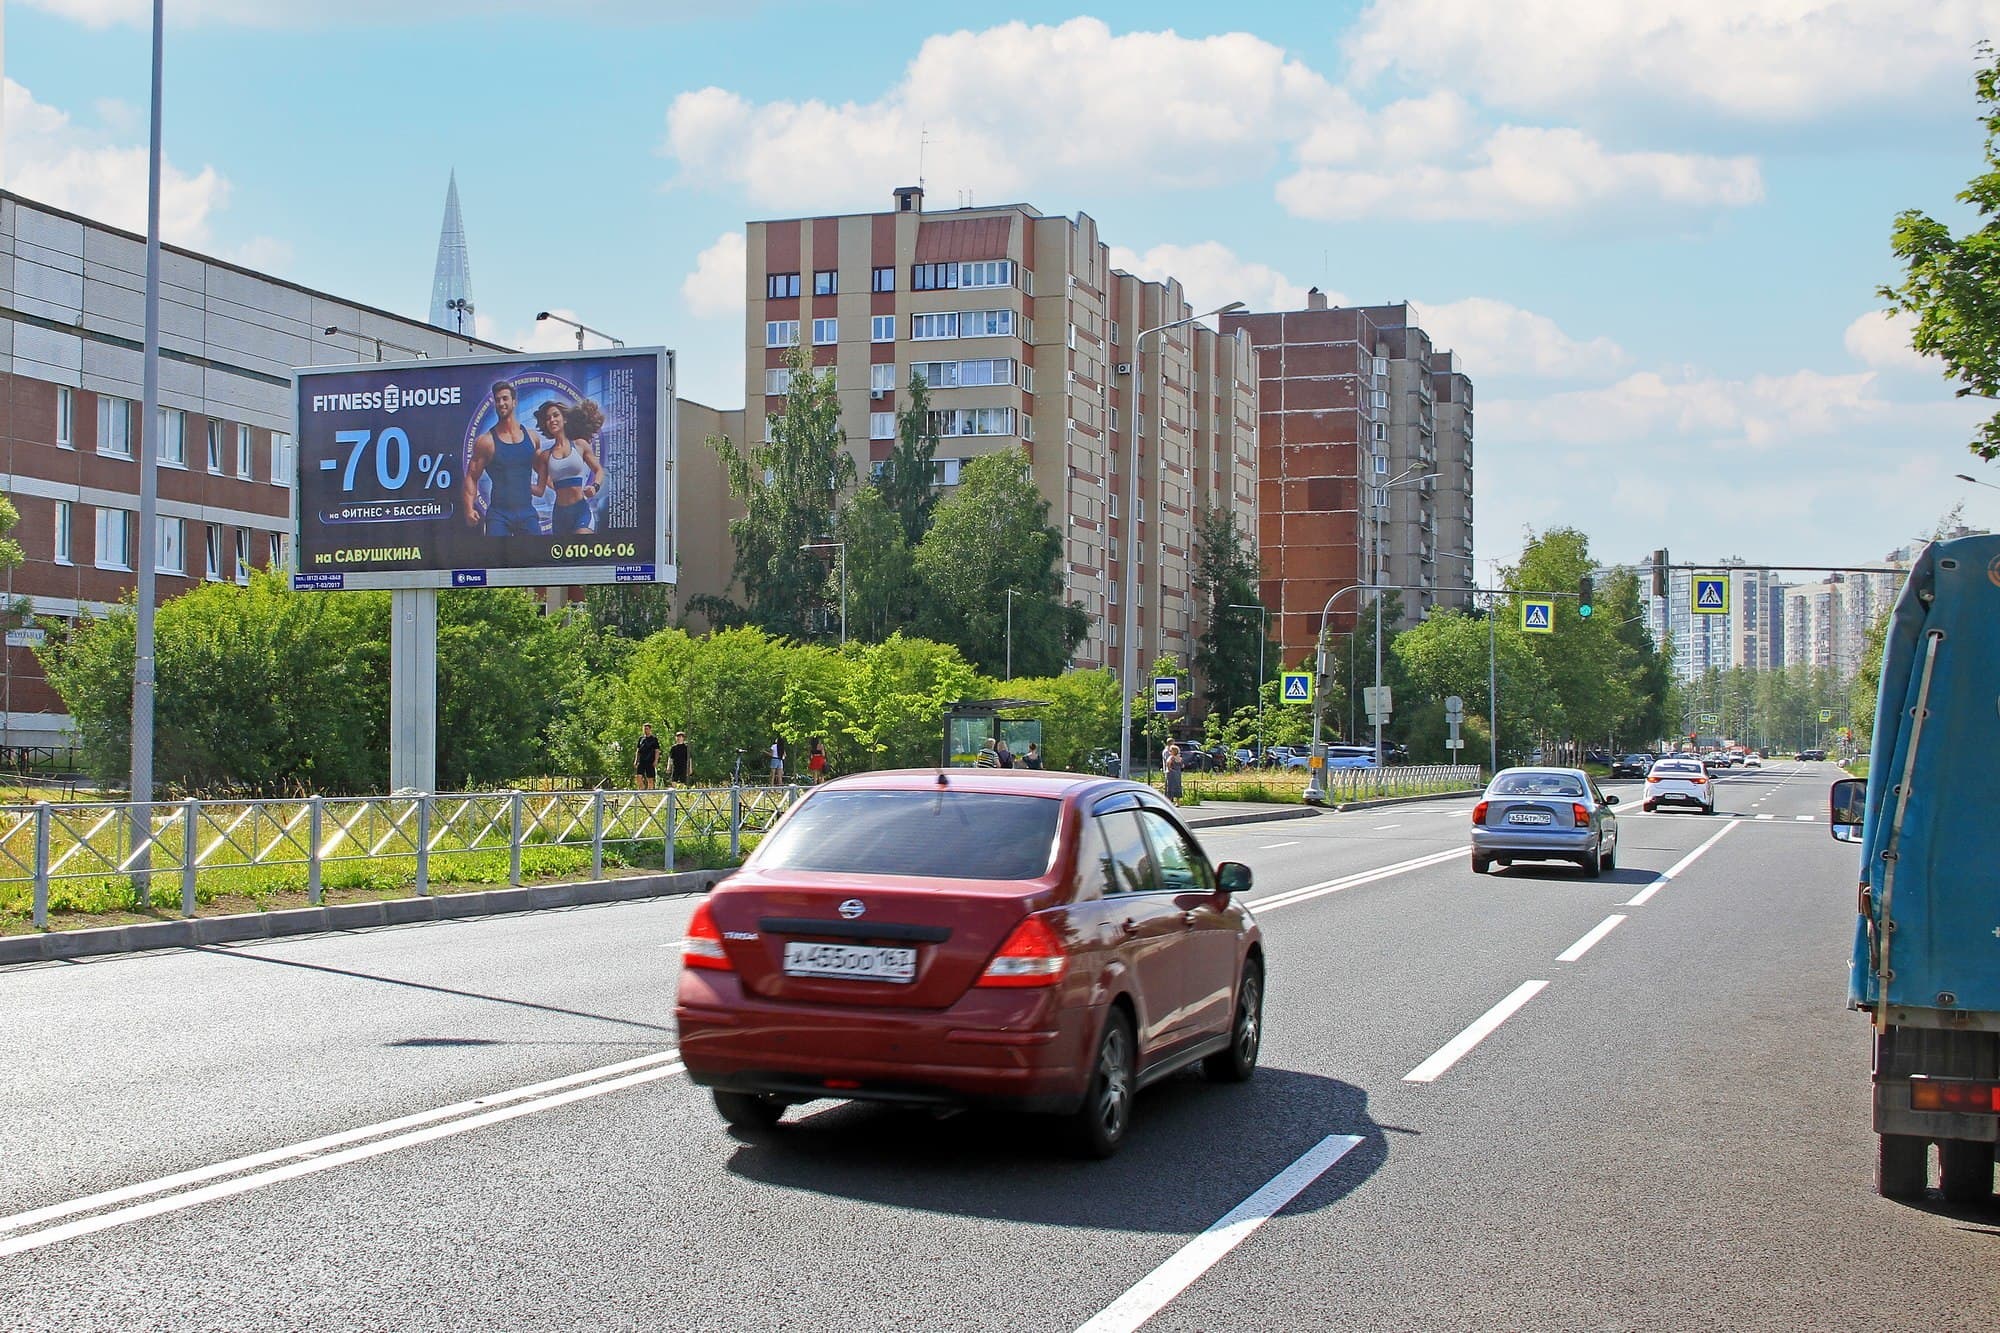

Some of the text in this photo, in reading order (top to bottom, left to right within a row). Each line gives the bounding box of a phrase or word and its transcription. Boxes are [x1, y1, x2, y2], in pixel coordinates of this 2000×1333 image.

[313, 386, 461, 412] FITNESS HOUSE
[342, 507, 383, 519] ФИТНЕС
[393, 502, 441, 516] БАССЕЙН
[315, 547, 422, 563] на САВУШКИНА
